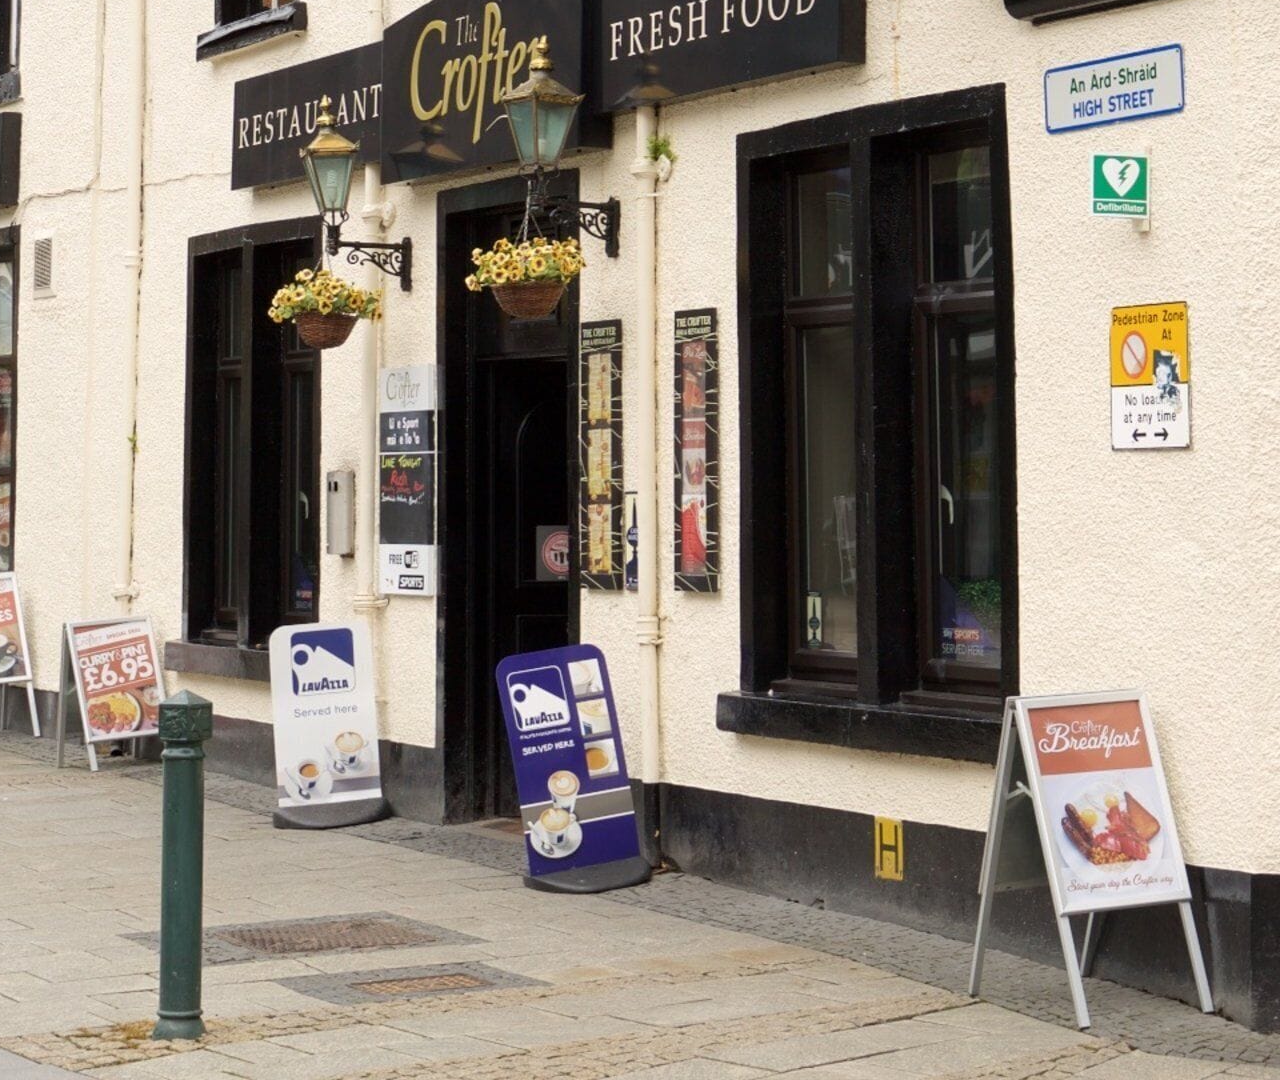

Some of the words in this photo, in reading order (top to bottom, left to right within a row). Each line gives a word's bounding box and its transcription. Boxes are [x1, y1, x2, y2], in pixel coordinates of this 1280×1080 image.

[456, 15, 478, 46] The
[1070, 77, 1086, 94] An
[1073, 98, 1103, 119] HIGH
[1108, 88, 1154, 113] STREET
[238, 84, 383, 149] RESTAUANT
[1096, 202, 1145, 213] Defibrillator
[1113, 312, 1158, 326] Pedestrian
[1162, 309, 1184, 322] Zone
[1162, 329, 1172, 340] At
[1125, 394, 1138, 406] No
[1124, 412, 1132, 423] at
[1137, 413, 1152, 424] any
[1156, 411, 1176, 422] time
[400, 576, 424, 589] SPORTS
[80, 650, 115, 669] CURRY
[121, 643, 146, 659] PINT
[84, 655, 154, 691] £6.95
[302, 677, 349, 692] LAVAZZA
[294, 707, 331, 718] Served
[334, 704, 358, 714] here
[525, 711, 564, 726] LAVAZZA
[522, 742, 553, 756] SERVED
[555, 740, 575, 750] HERE
[1039, 723, 1141, 759] Breakfast
[879, 822, 899, 874] H
